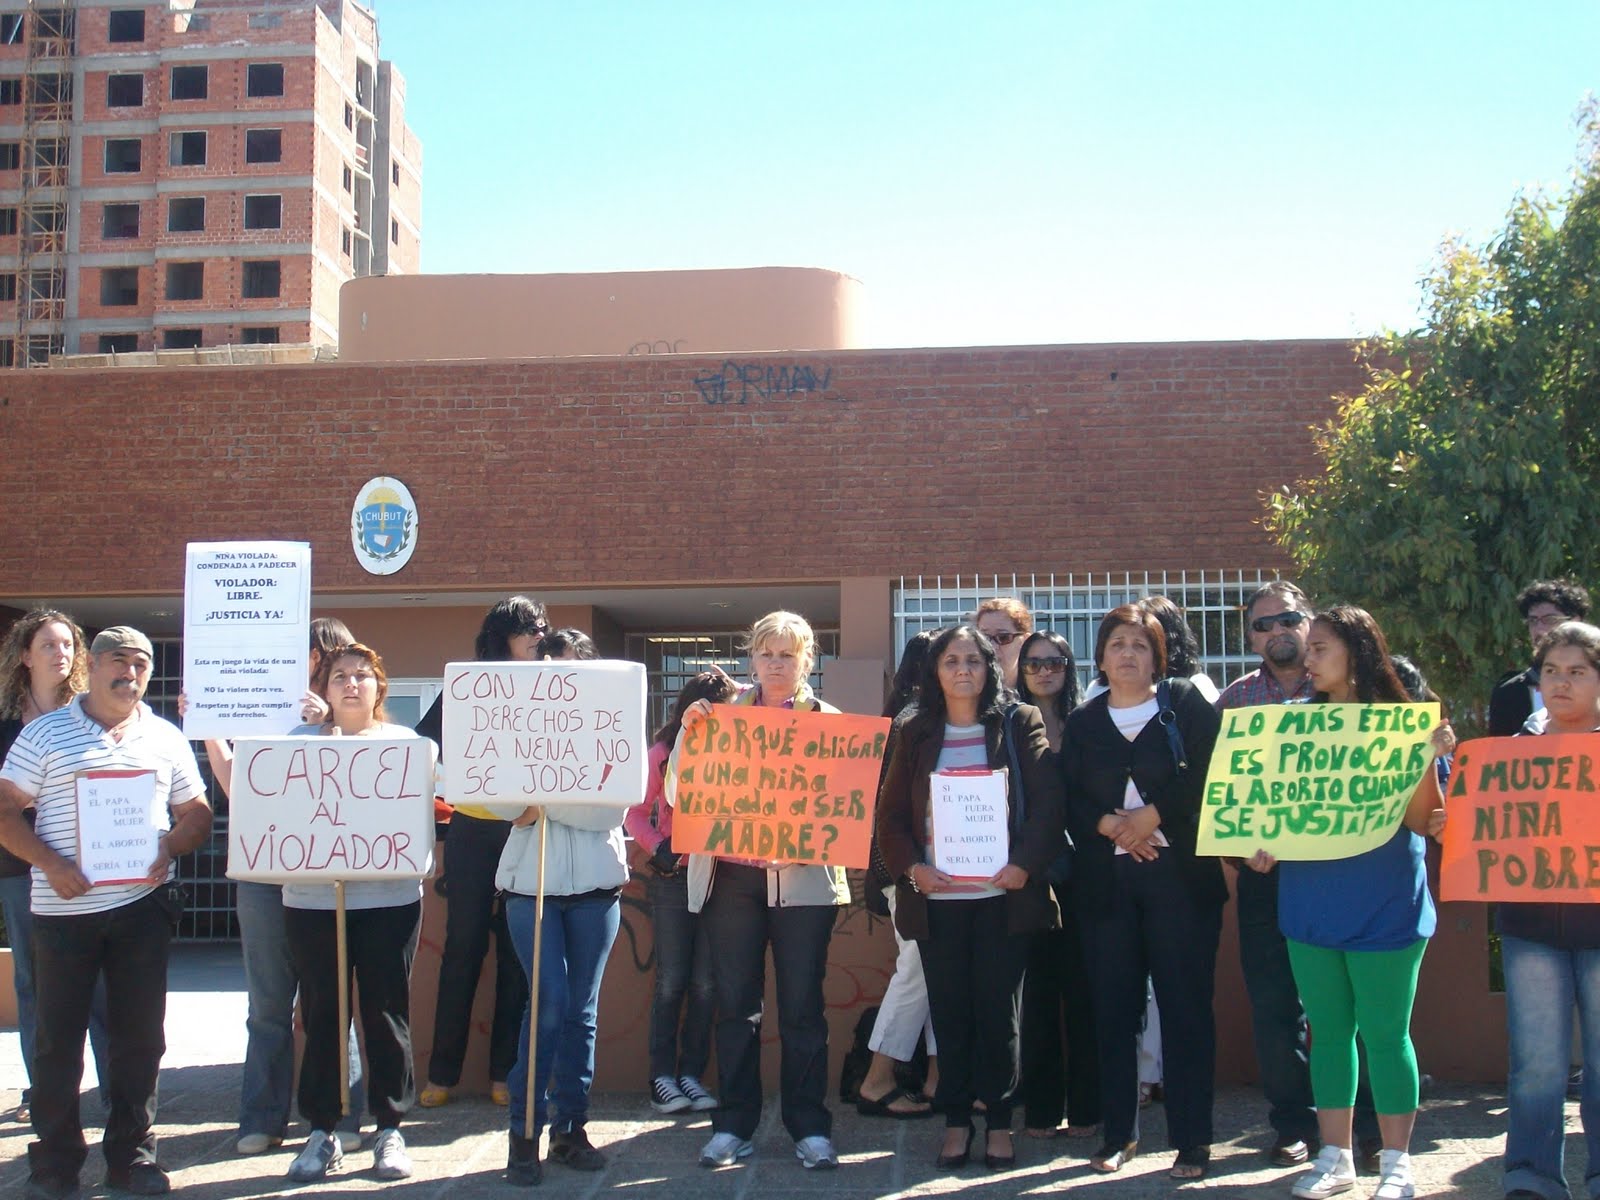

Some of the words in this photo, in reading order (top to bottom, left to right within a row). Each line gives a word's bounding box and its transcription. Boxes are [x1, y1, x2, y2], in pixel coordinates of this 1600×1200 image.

[365, 511, 402, 521] CHUBUT
[238, 552, 279, 560] VIOLADA:
[196, 562, 248, 570] CONDENADA
[258, 561, 297, 569] PADECER
[214, 578, 278, 588] VIOLADOR:
[226, 591, 263, 601] LIBRE.
[205, 610, 261, 622] ¡JUSTICIA
[264, 610, 284, 620] YA!
[194, 658, 210, 666] Esta
[222, 660, 242, 668] juego
[244, 658, 251, 666] la
[253, 658, 269, 666] vida
[219, 667, 237, 675] niña
[238, 667, 269, 675] violada:
[451, 671, 515, 701] CON
[530, 672, 578, 702] LOS
[195, 702, 229, 711] Respeten
[237, 702, 260, 710] hagan
[261, 701, 293, 710] cumplir
[470, 704, 583, 733] DERECHOS
[593, 710, 624, 733] DE
[1227, 711, 1266, 740] LO
[1275, 704, 1345, 735] MÁS
[464, 734, 500, 760] LA
[515, 736, 579, 762] NENA
[596, 738, 631, 763] NO
[1229, 748, 1264, 776] ES
[1278, 736, 1429, 774] PROVOCAR
[464, 765, 498, 796] SE
[522, 763, 614, 795] JODE!
[88, 788, 98, 797] SI
[942, 784, 952, 793] SI
[1206, 781, 1240, 806] EL
[1246, 775, 1344, 805] ABORTO
[89, 799, 101, 808] EL
[105, 797, 130, 807] PAPA
[943, 795, 954, 803] EL
[958, 794, 982, 803] PAPA
[813, 789, 866, 821] SER
[965, 804, 995, 813] FUERA
[113, 807, 144, 817] FUERA
[309, 801, 347, 826] AL
[113, 817, 145, 827] MUJER
[965, 814, 996, 823] MUJER
[1213, 806, 1255, 840] SE
[92, 841, 104, 850] EL
[108, 838, 147, 849] ABORTO
[703, 819, 839, 862] MADRE?
[944, 835, 957, 844] EL
[960, 835, 997, 844] ABORTO
[127, 860, 146, 869] LEY
[977, 856, 995, 864] LEY
